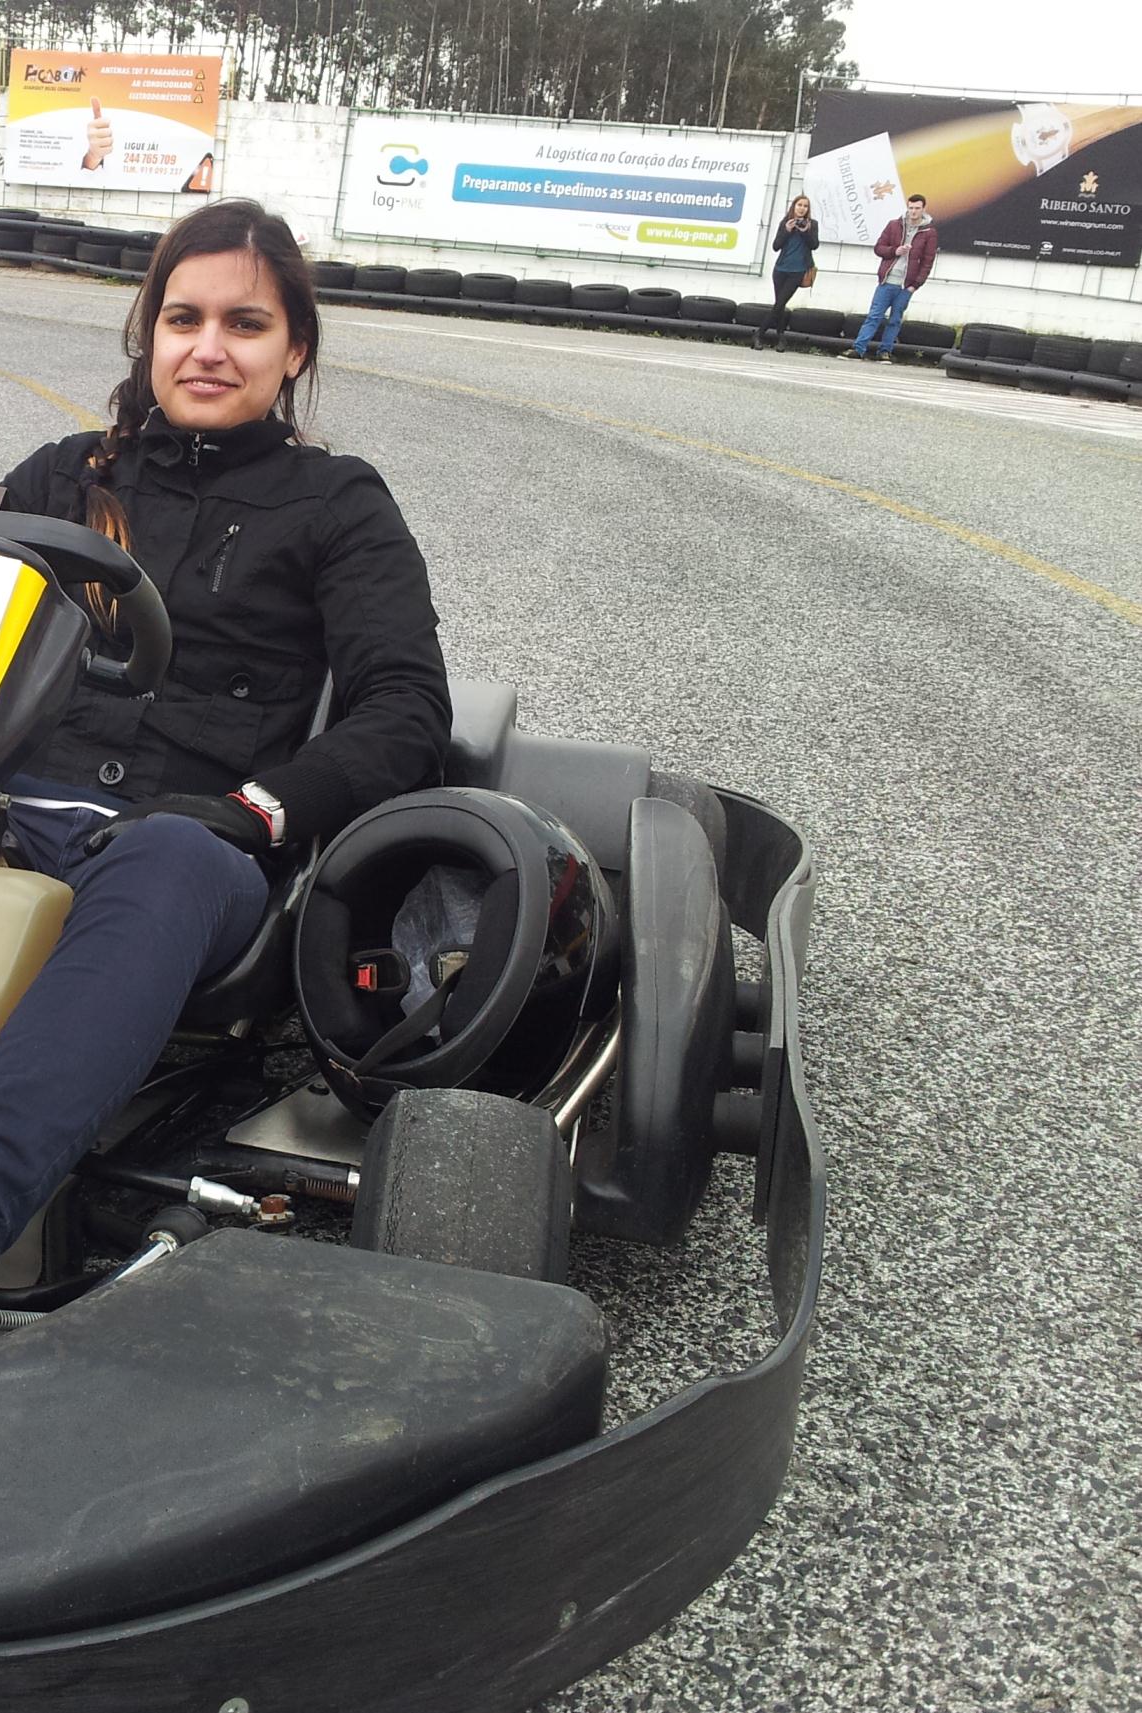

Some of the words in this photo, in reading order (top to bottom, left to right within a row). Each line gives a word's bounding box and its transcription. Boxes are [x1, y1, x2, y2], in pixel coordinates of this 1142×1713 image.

[124, 142, 145, 151] LIGUE
[123, 152, 140, 163] 244
[142, 153, 158, 165] 765
[160, 154, 177, 165] 709
[535, 146, 544, 158] A
[546, 147, 598, 163] Logística
[600, 153, 615, 163] no
[618, 151, 665, 169] Coração
[668, 154, 688, 169] das
[691, 156, 750, 174] Empresas
[462, 174, 532, 193] Preparamos
[534, 183, 542, 193] e
[544, 180, 608, 200] Expedimos
[610, 189, 624, 200] as
[626, 190, 652, 202] suas
[654, 190, 733, 209] encomendas
[838, 153, 858, 202] RIBEIRO
[849, 203, 870, 242] SANTO
[1039, 198, 1087, 213] RIBEIRO
[1088, 201, 1131, 215] SANTO
[1040, 218, 1124, 230] www.winemagnum.com
[646, 227, 727, 244] www.log-pme.pt
